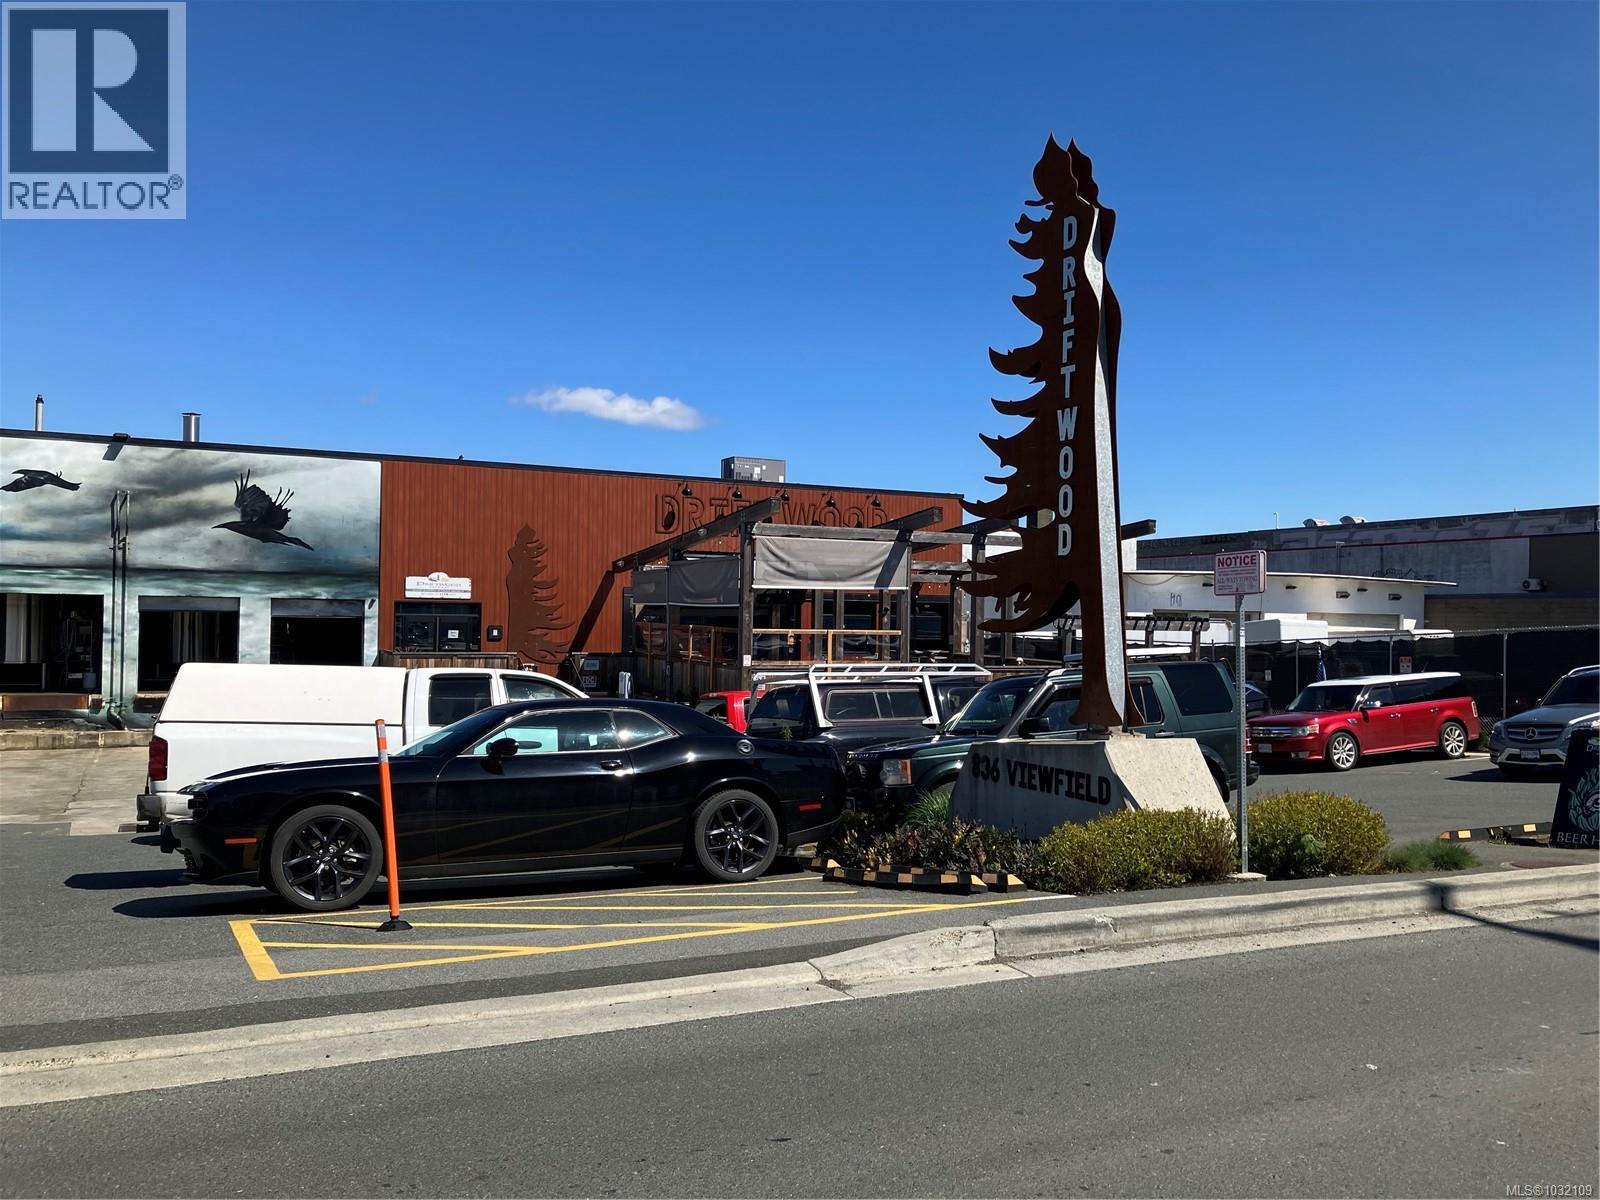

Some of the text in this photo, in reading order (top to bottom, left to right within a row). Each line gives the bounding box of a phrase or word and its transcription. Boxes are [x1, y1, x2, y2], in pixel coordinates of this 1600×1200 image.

[1056, 215, 1078, 557] DRIFTWOOD
[1217, 554, 1257, 568] NOTICE
[971, 752, 1112, 806] 836 VIEWFIELD
[1557, 831, 1588, 845] BEER
